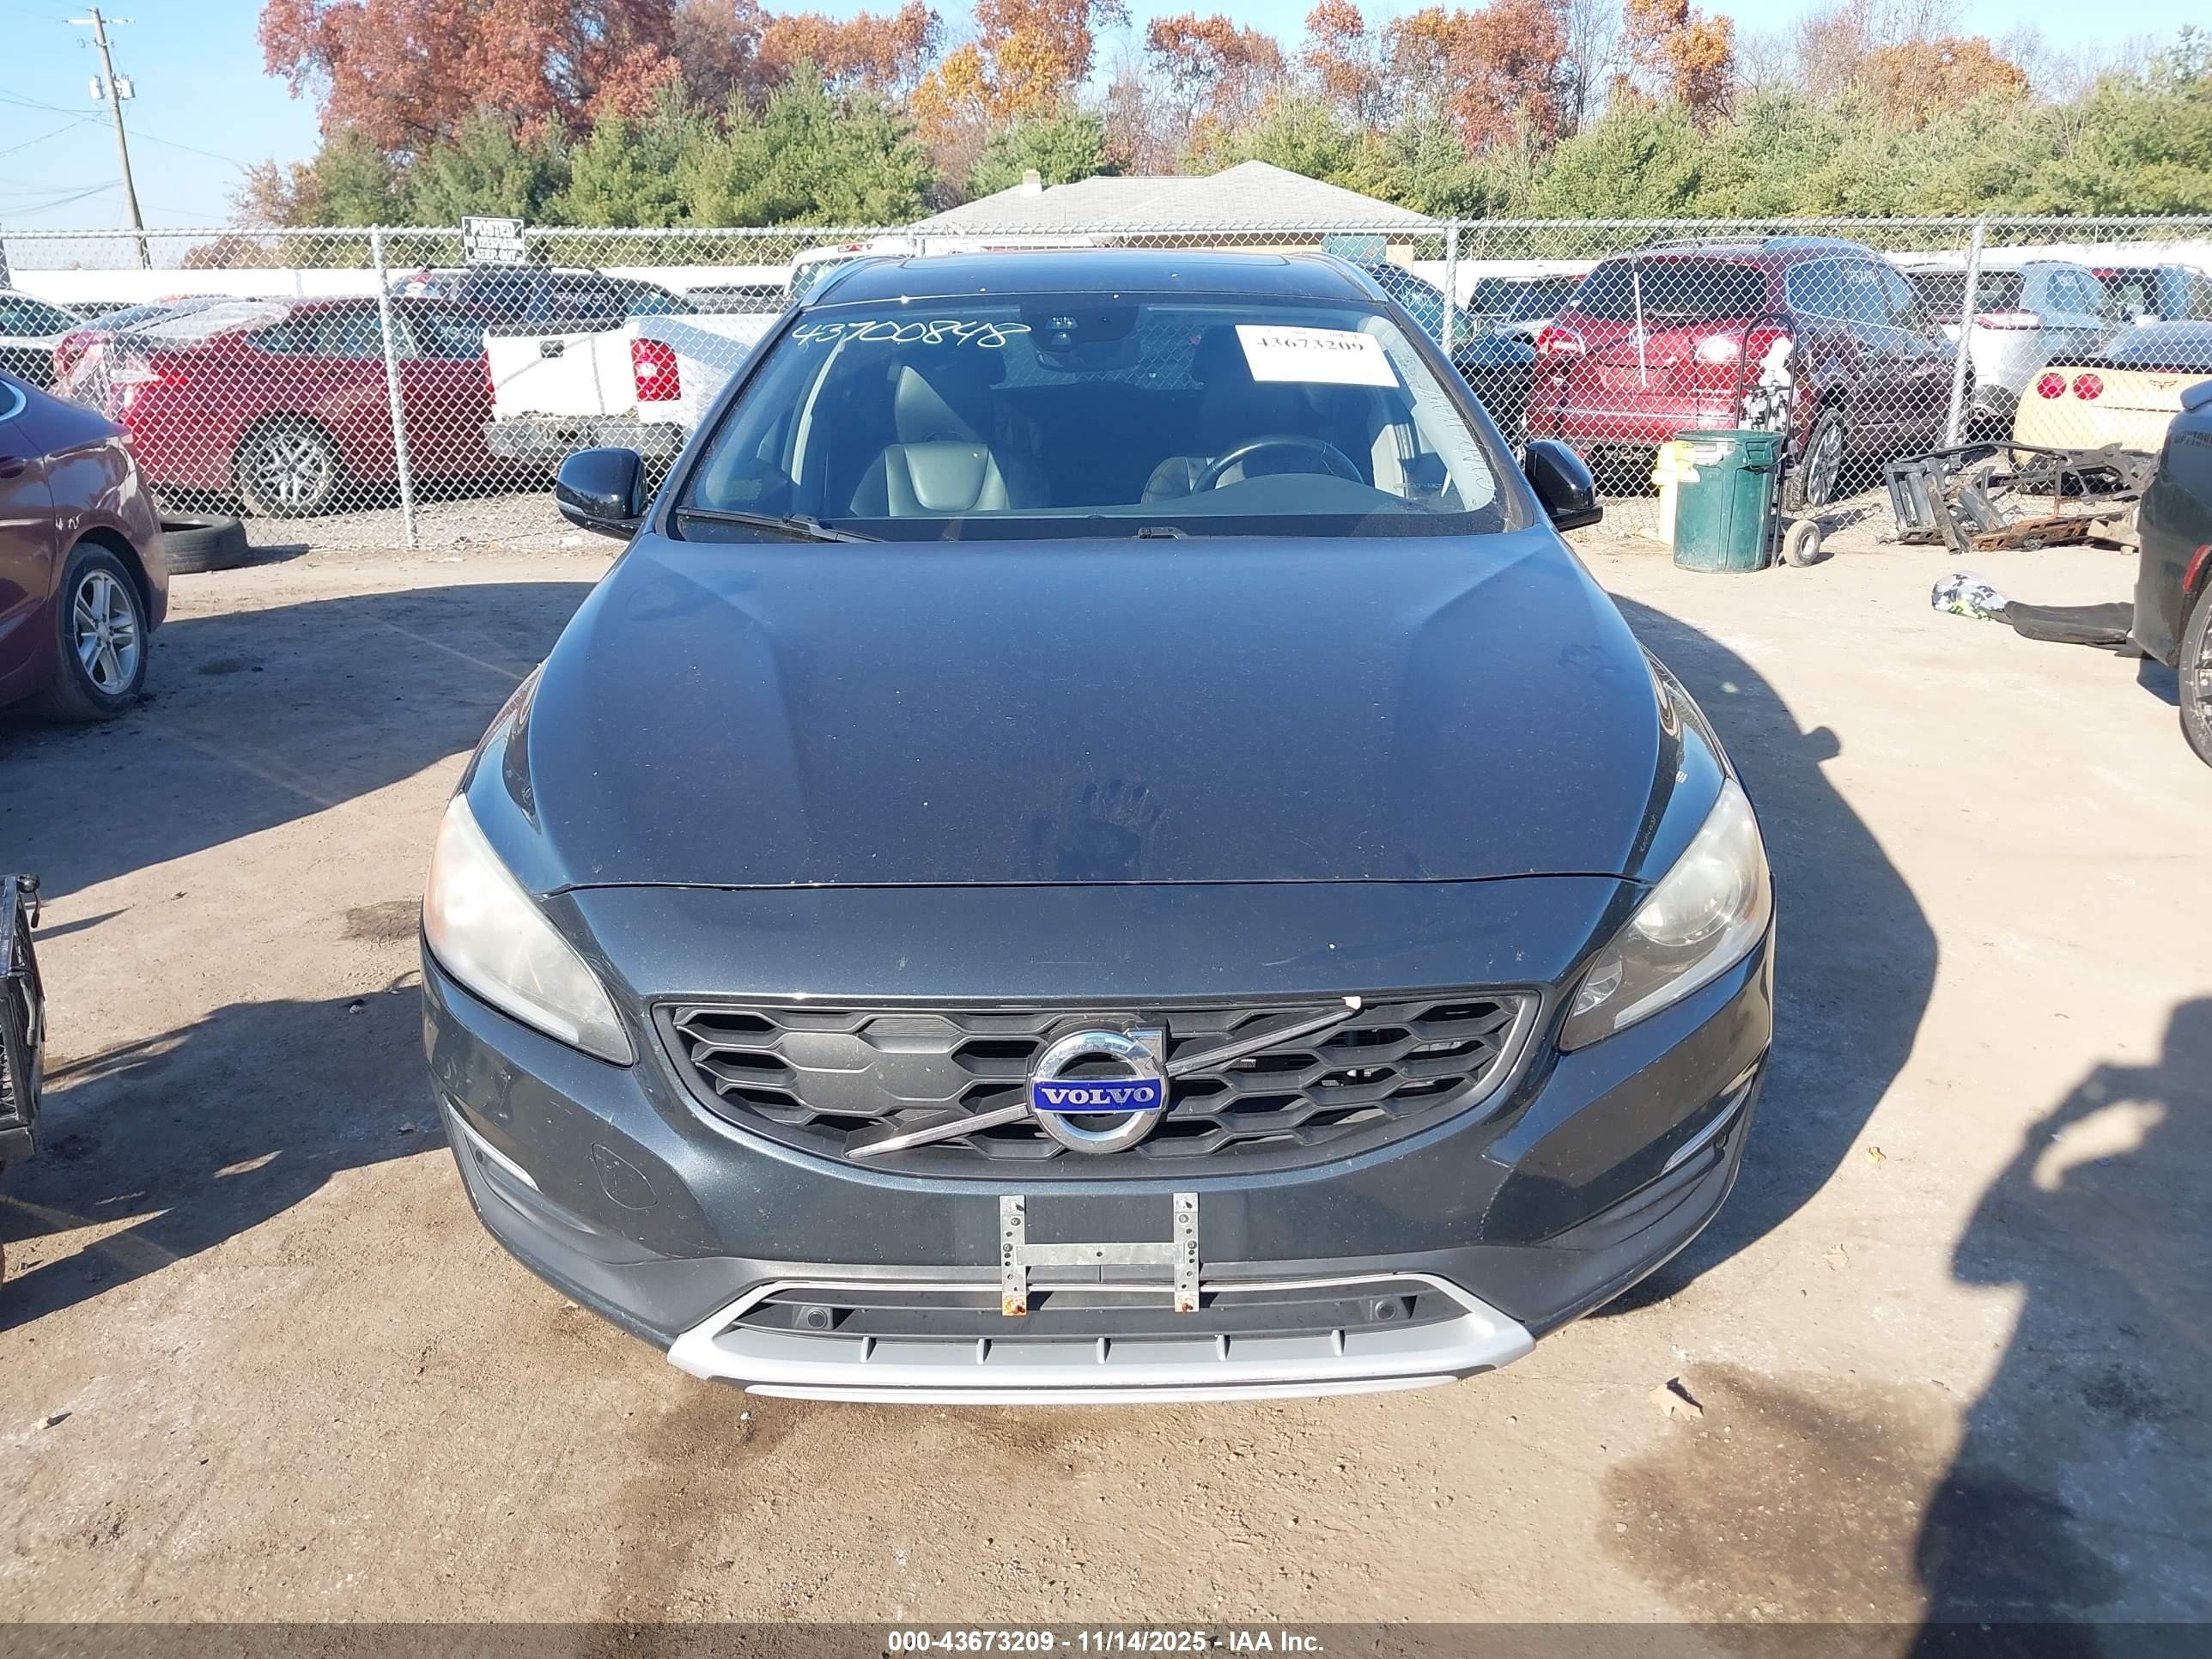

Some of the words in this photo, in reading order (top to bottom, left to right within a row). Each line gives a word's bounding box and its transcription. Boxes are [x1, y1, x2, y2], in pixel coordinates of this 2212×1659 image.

[470, 219, 515, 237] POSTED
[473, 248, 497, 259] KEEP
[499, 249, 517, 261] OUT
[792, 320, 1032, 348] 43700848
[1256, 337, 1364, 351] 43673209
[1041, 1087, 1155, 1105] VOLVO
